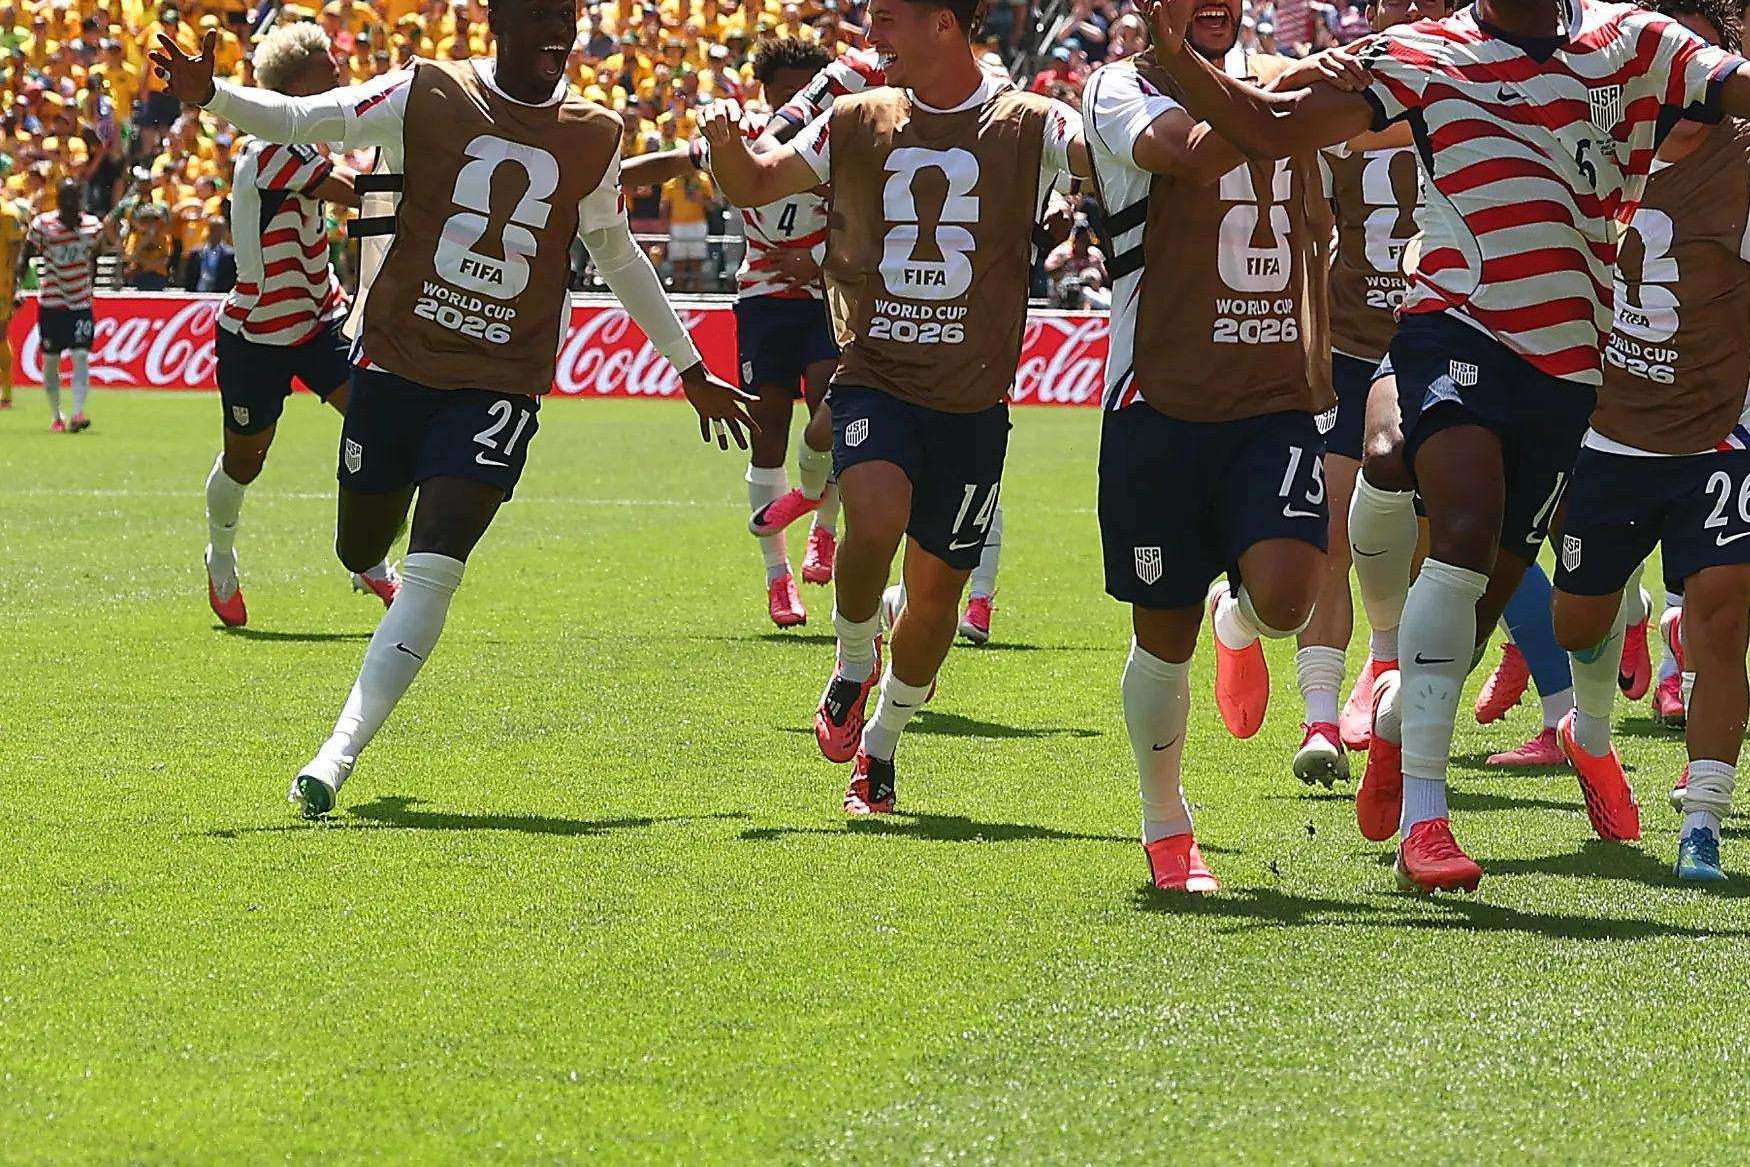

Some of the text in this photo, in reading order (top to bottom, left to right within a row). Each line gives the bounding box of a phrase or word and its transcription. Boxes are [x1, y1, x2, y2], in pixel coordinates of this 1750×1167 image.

[1591, 85, 1618, 107] USA
[777, 203, 797, 236] 4
[459, 258, 503, 284] FIFA
[904, 269, 946, 285] FIFA
[1246, 257, 1280, 275] FIFA
[422, 281, 517, 321] WORLD CUP
[874, 299, 967, 320] WORLD CUP
[1216, 298, 1293, 315] WORLD CUP
[74, 319, 92, 343] 20
[413, 297, 512, 344] 2026
[868, 316, 965, 344] 2026
[1213, 318, 1298, 344] 2026
[1643, 347, 1679, 362] CUP
[472, 399, 530, 456] 21
[1279, 446, 1324, 504] 15
[952, 482, 999, 534] 14
[1136, 548, 1160, 563] USA
